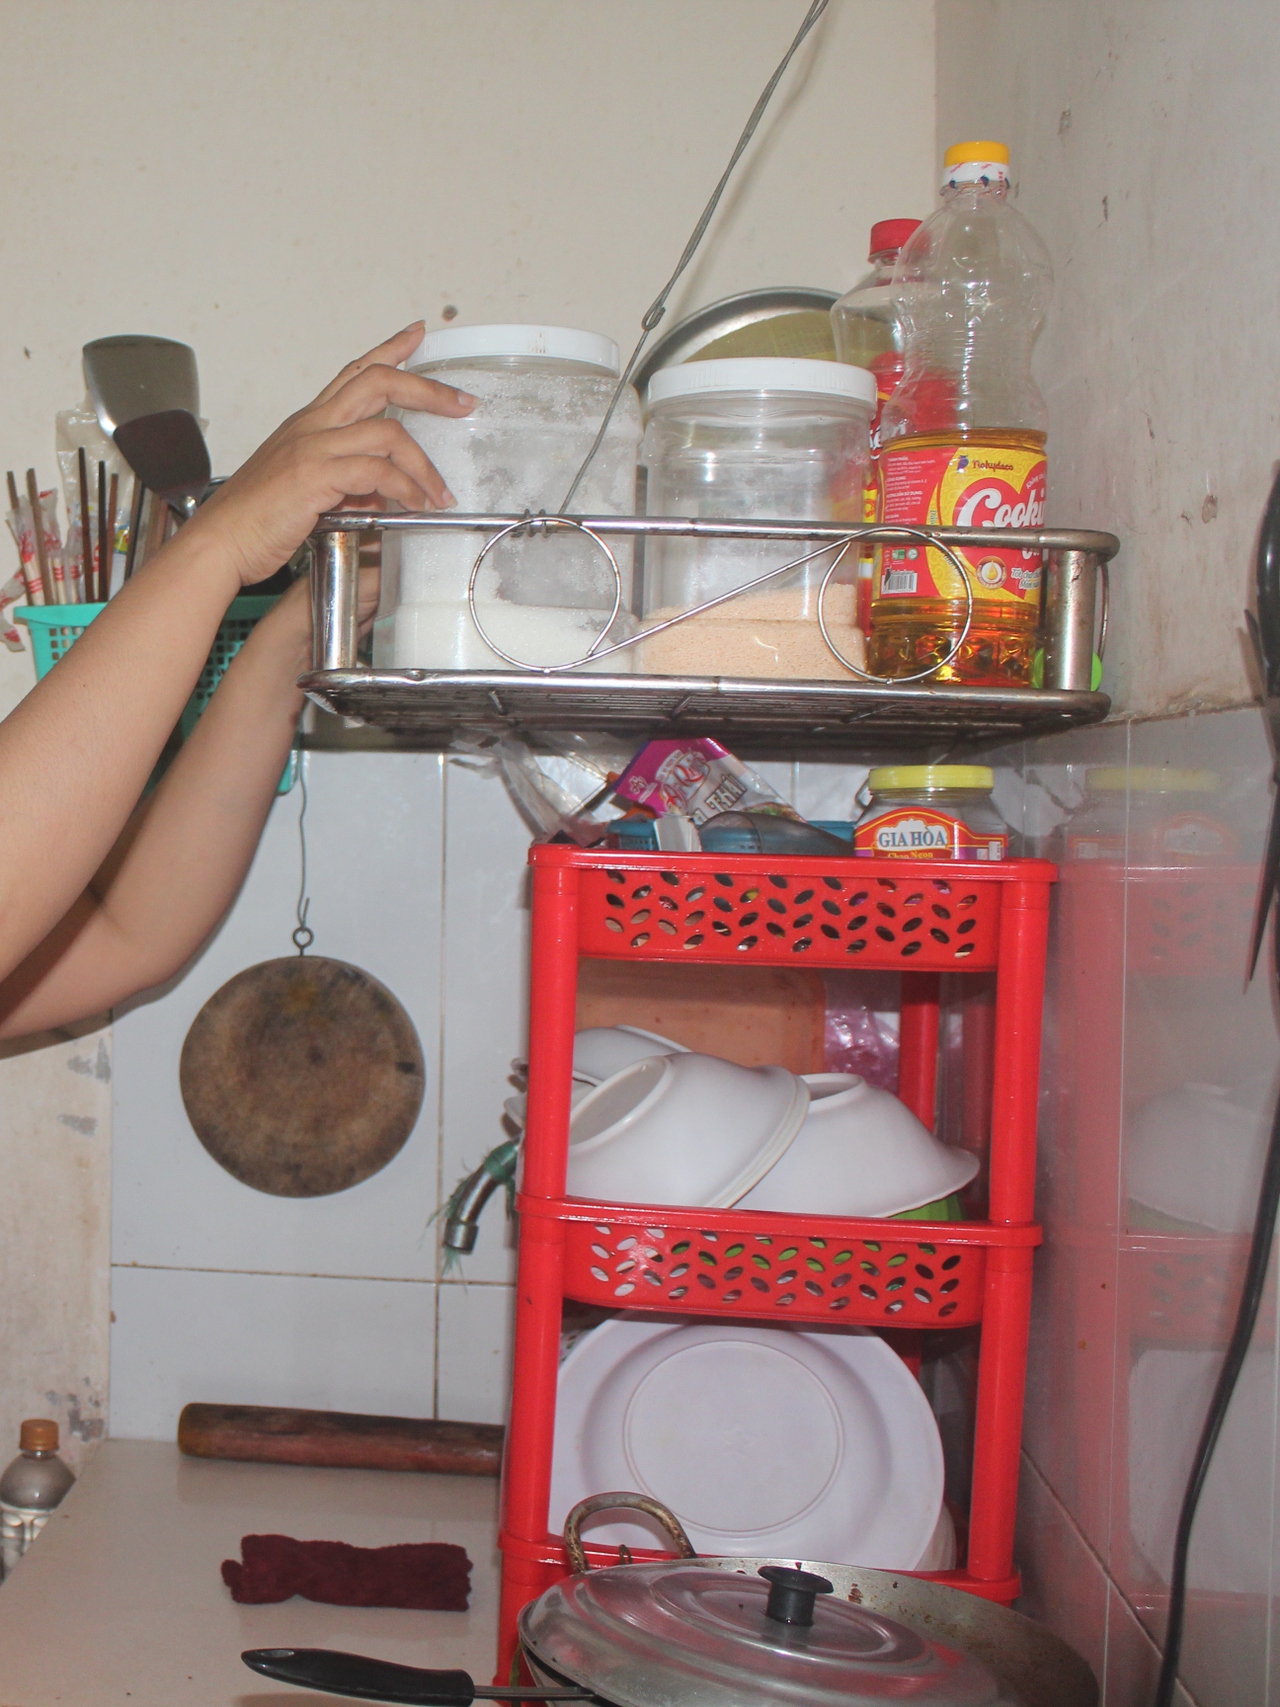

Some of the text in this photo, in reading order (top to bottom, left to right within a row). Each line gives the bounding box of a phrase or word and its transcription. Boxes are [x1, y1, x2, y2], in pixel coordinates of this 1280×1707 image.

[956, 487, 1045, 528] Cooki
[878, 826, 947, 848] GIA HÒA
